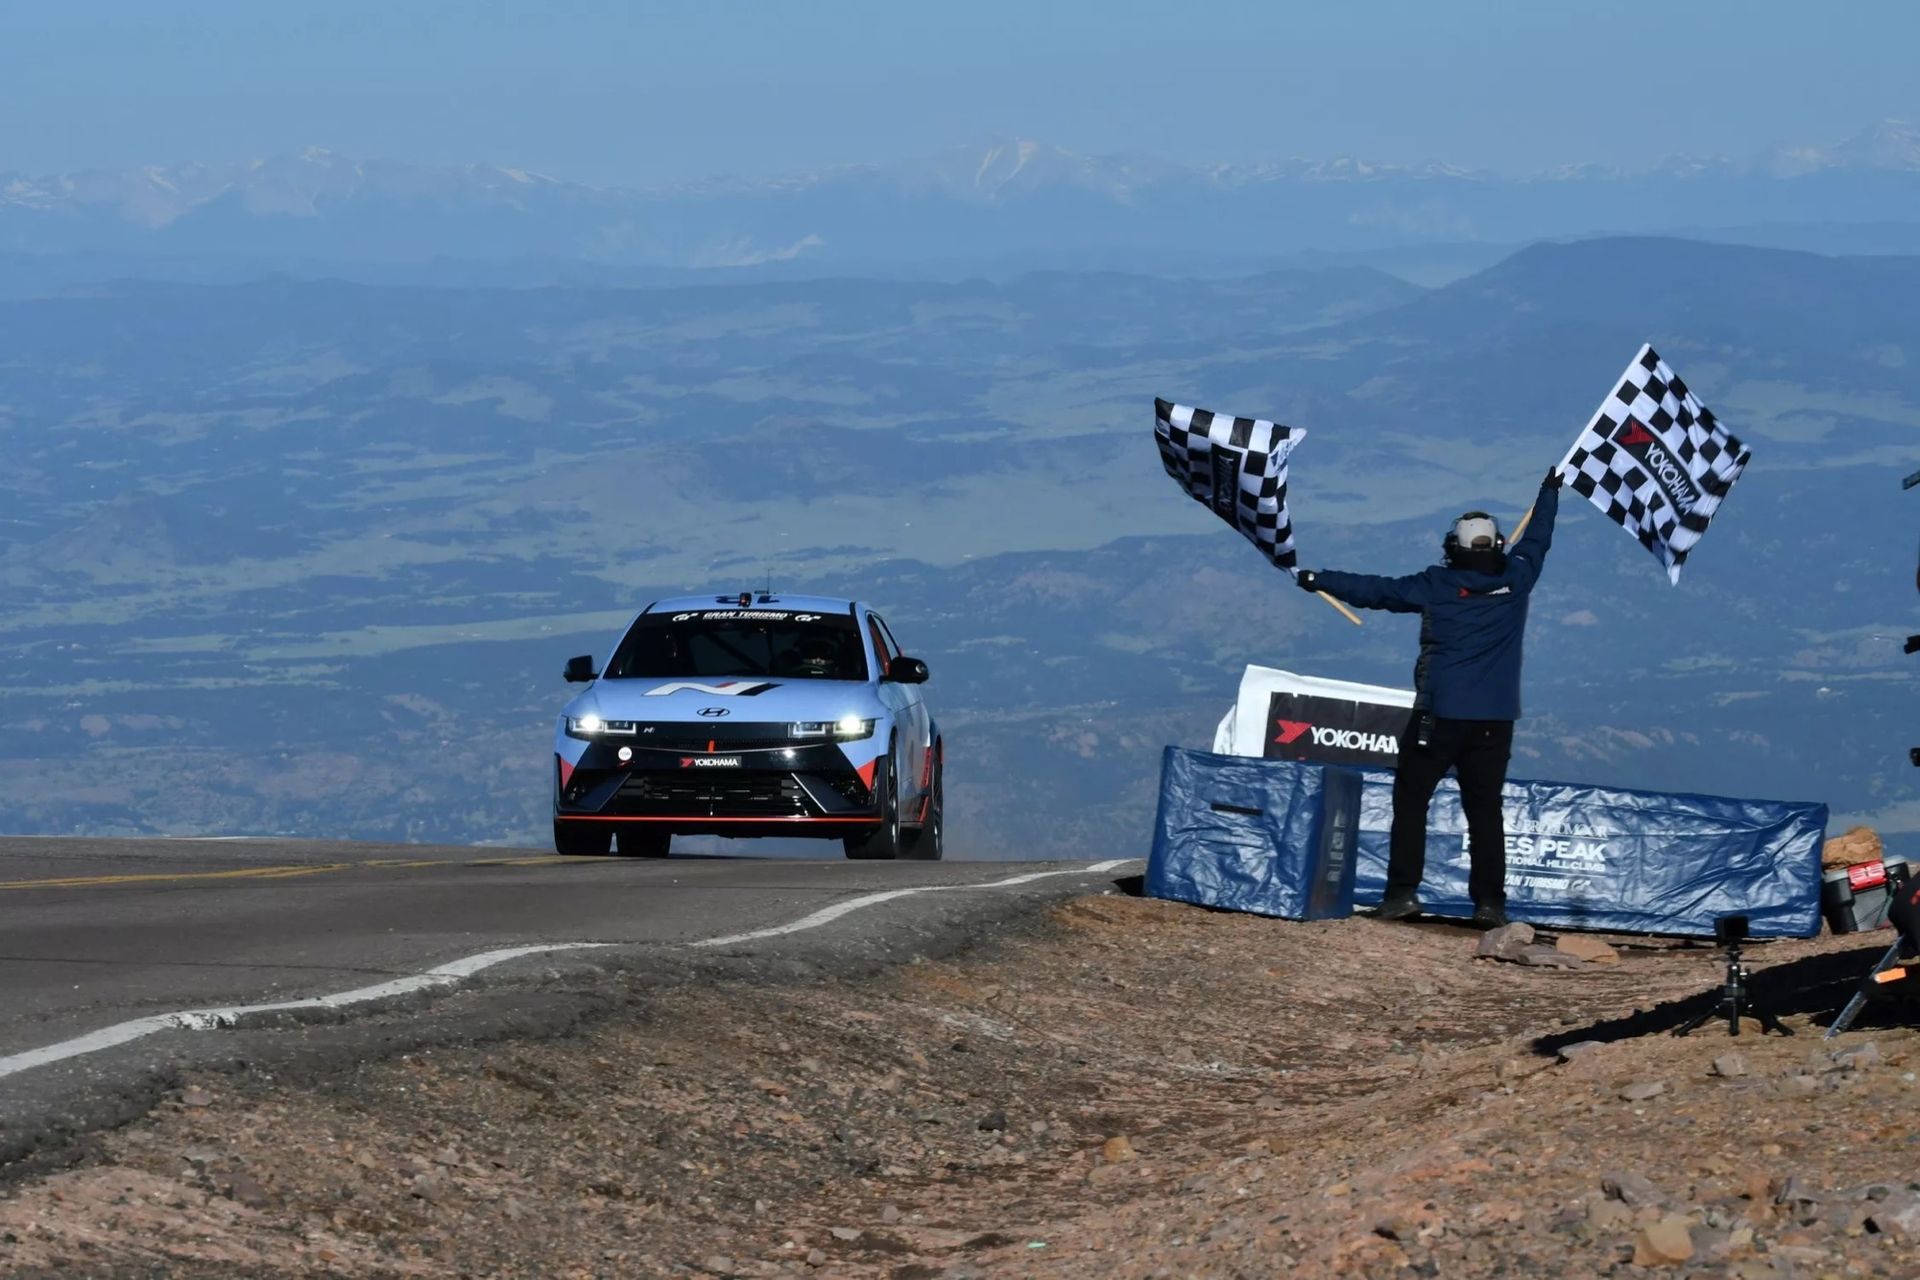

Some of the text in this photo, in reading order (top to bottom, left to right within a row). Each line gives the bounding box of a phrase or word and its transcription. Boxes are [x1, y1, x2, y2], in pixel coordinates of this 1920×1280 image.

[1644, 441, 1696, 516] YOKOHAMA
[703, 611, 737, 619] GRAN
[738, 611, 788, 619] TURISMO
[1310, 726, 1400, 754] YOKOHAM
[694, 758, 738, 767] YOKOHAMA
[1539, 838, 1607, 862] PEAK
[1546, 859, 1570, 869] HILL
[1570, 861, 1606, 872] CLIMB
[1523, 876, 1569, 890] TURISMO
